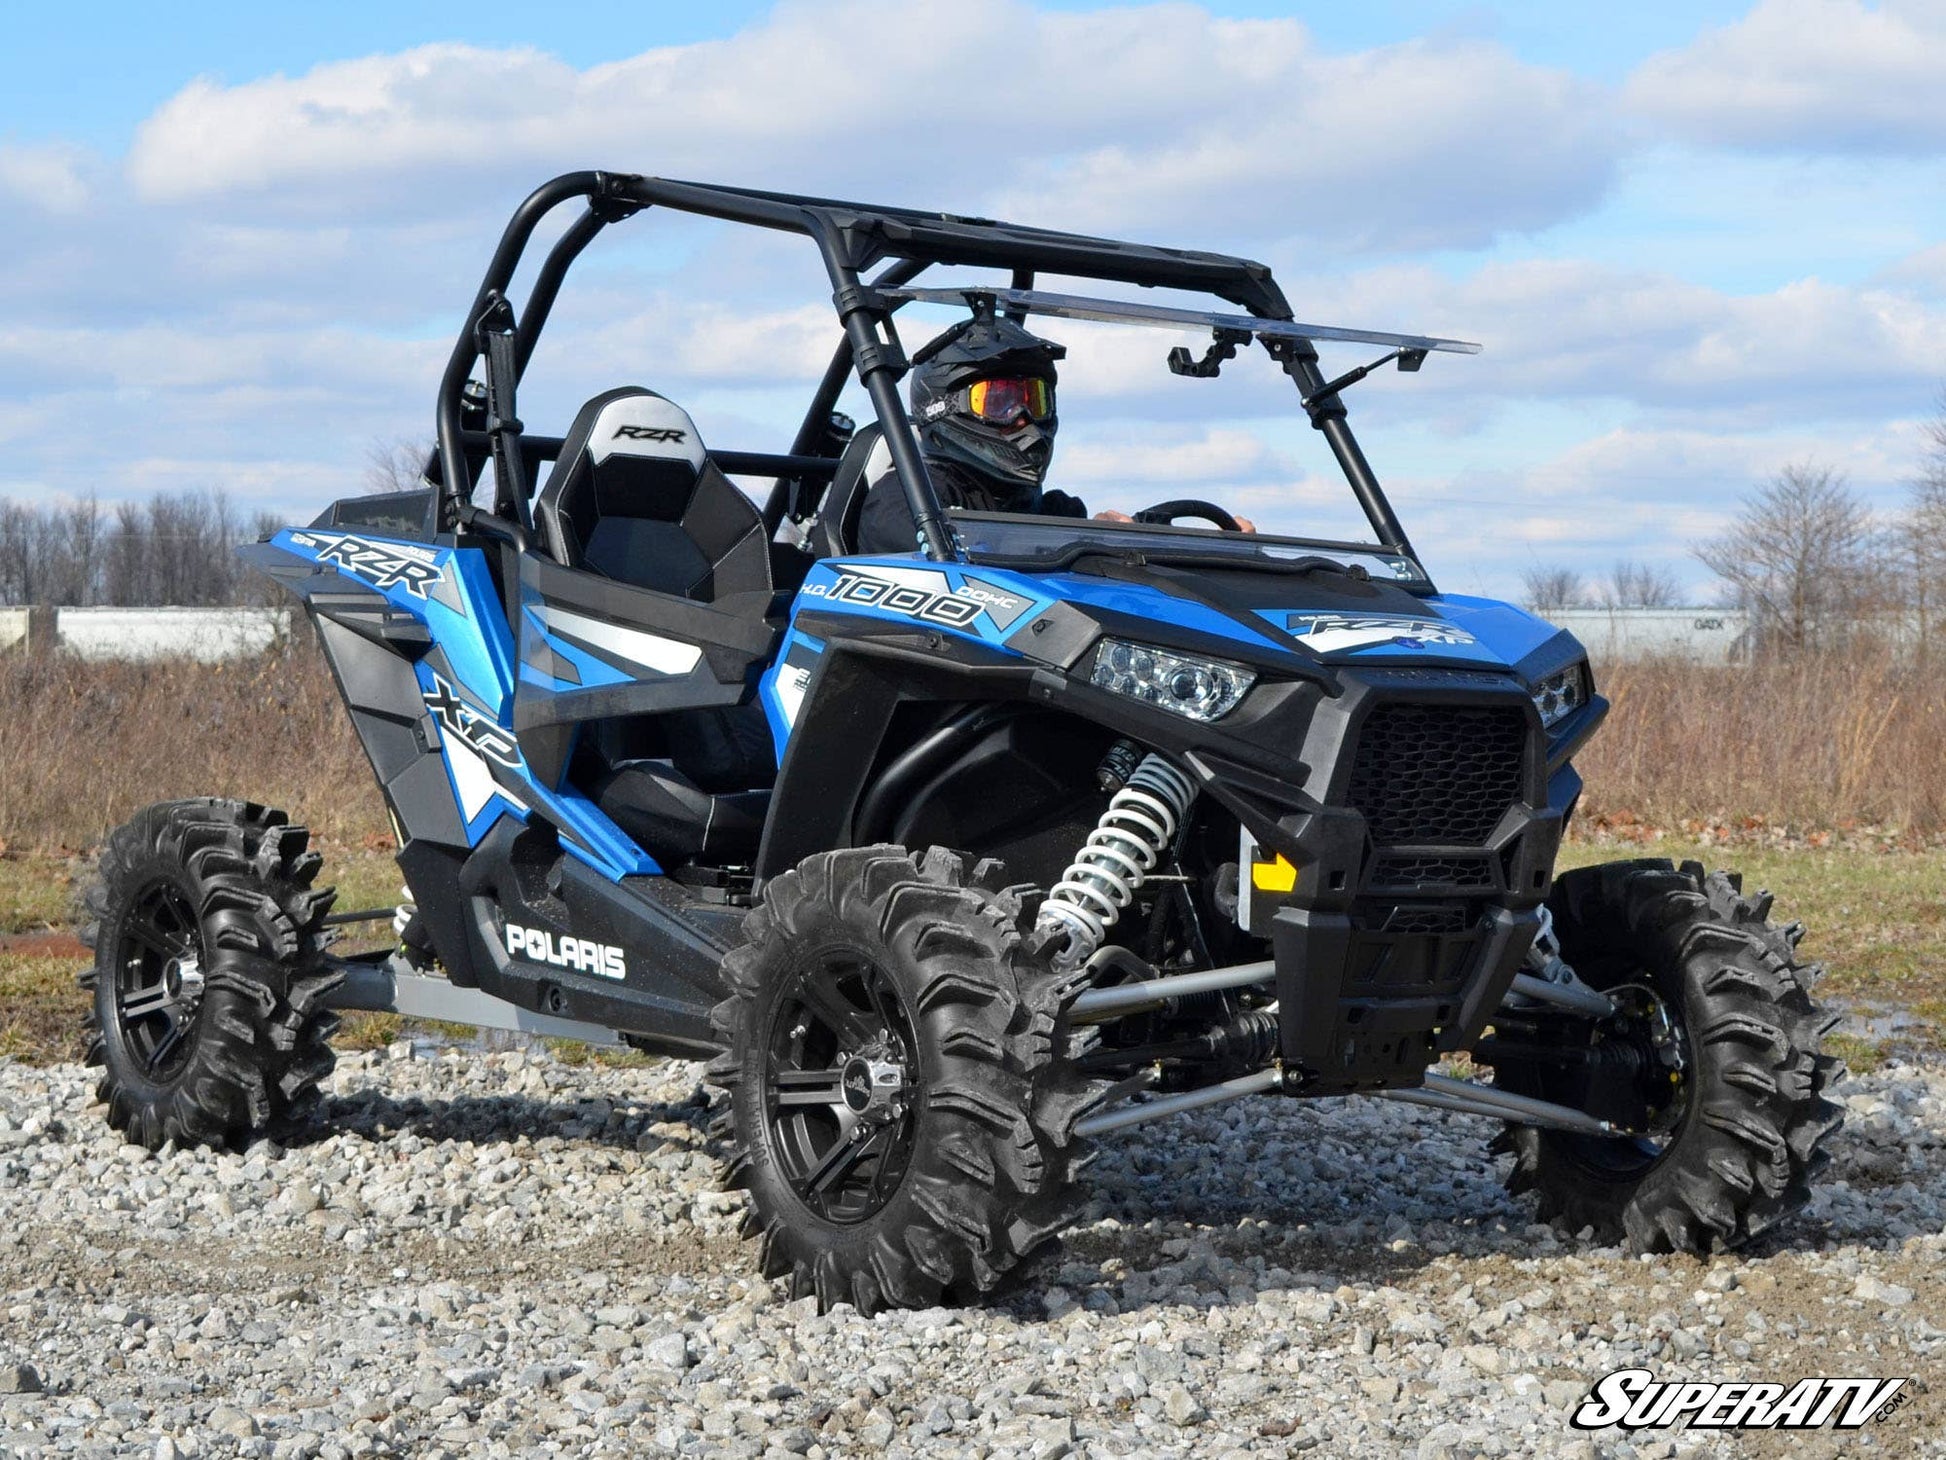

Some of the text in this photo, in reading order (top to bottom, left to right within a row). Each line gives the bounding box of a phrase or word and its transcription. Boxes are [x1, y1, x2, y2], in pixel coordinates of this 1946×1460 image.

[611, 425, 687, 444] RZR
[315, 534, 446, 600] RZR
[824, 574, 986, 627] 1000
[955, 586, 1018, 609] DOHC
[422, 671, 524, 767] XP
[506, 923, 626, 980] POLARIS
